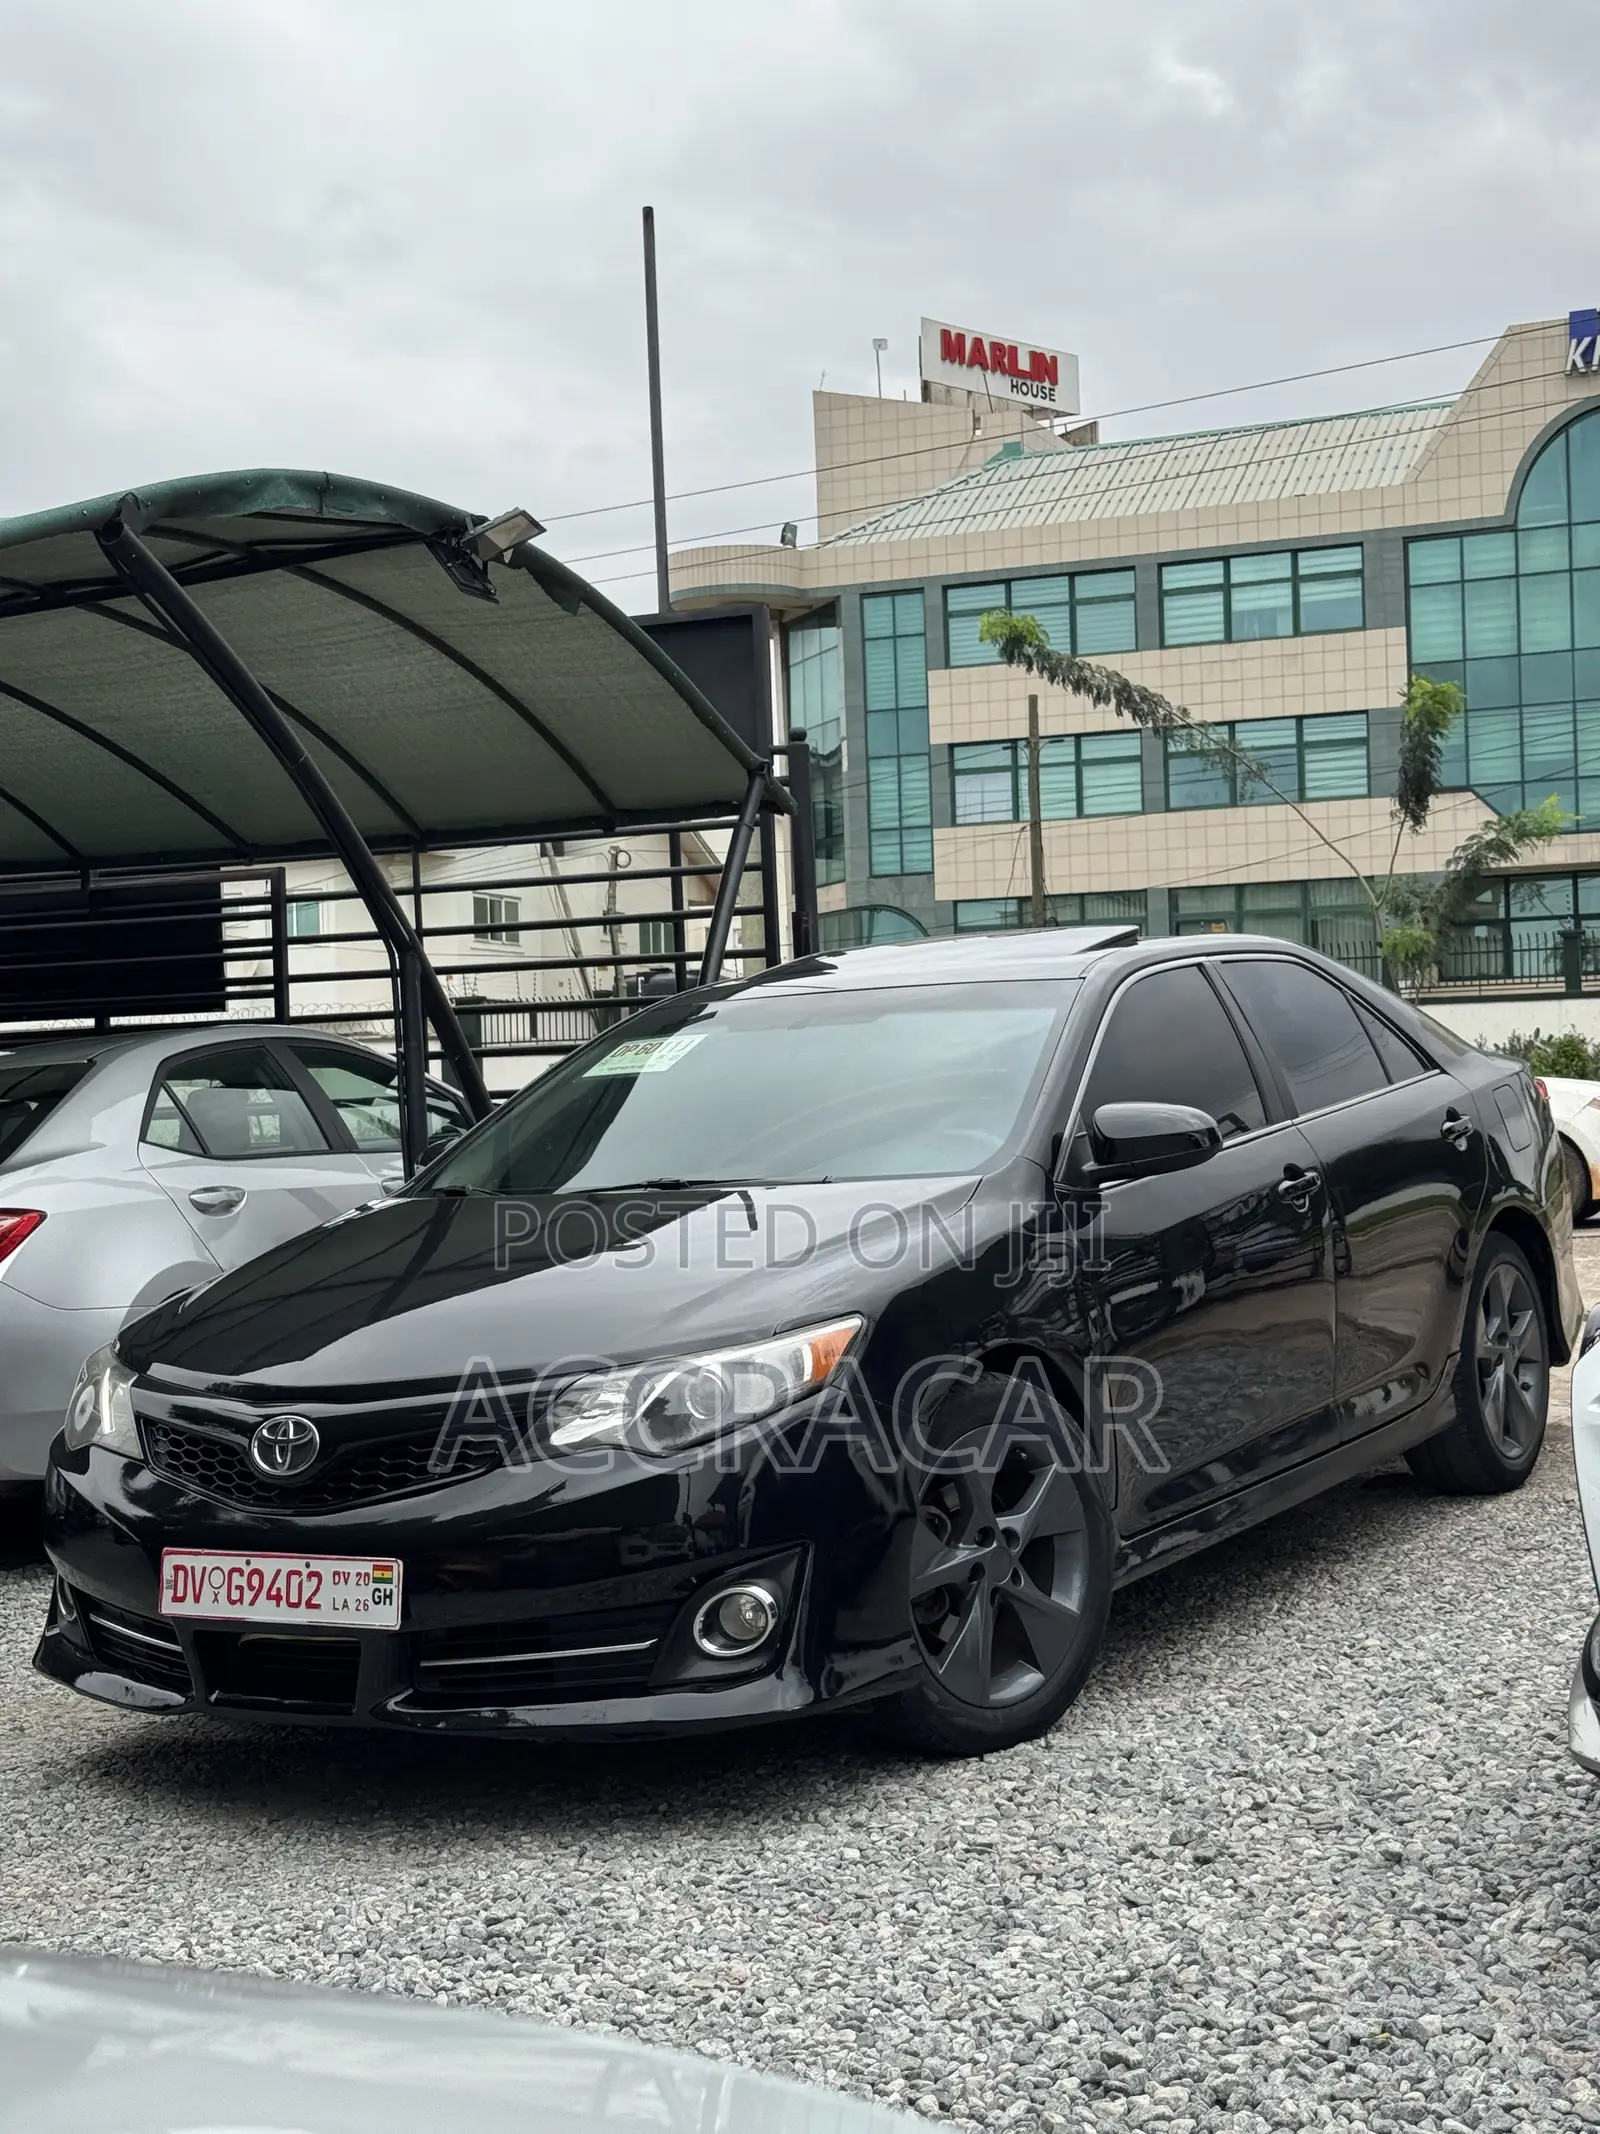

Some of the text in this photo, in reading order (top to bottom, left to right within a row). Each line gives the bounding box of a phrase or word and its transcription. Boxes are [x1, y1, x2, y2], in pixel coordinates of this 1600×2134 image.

[940, 328, 1058, 386] MARLIN
[1010, 379, 1056, 402] HOUSE
[171, 1564, 207, 1604] DV
[227, 1566, 323, 1610] G9402
[332, 1570, 370, 1586] DV 20
[332, 1596, 370, 1612] LA 26
[372, 1587, 393, 1606] GH
